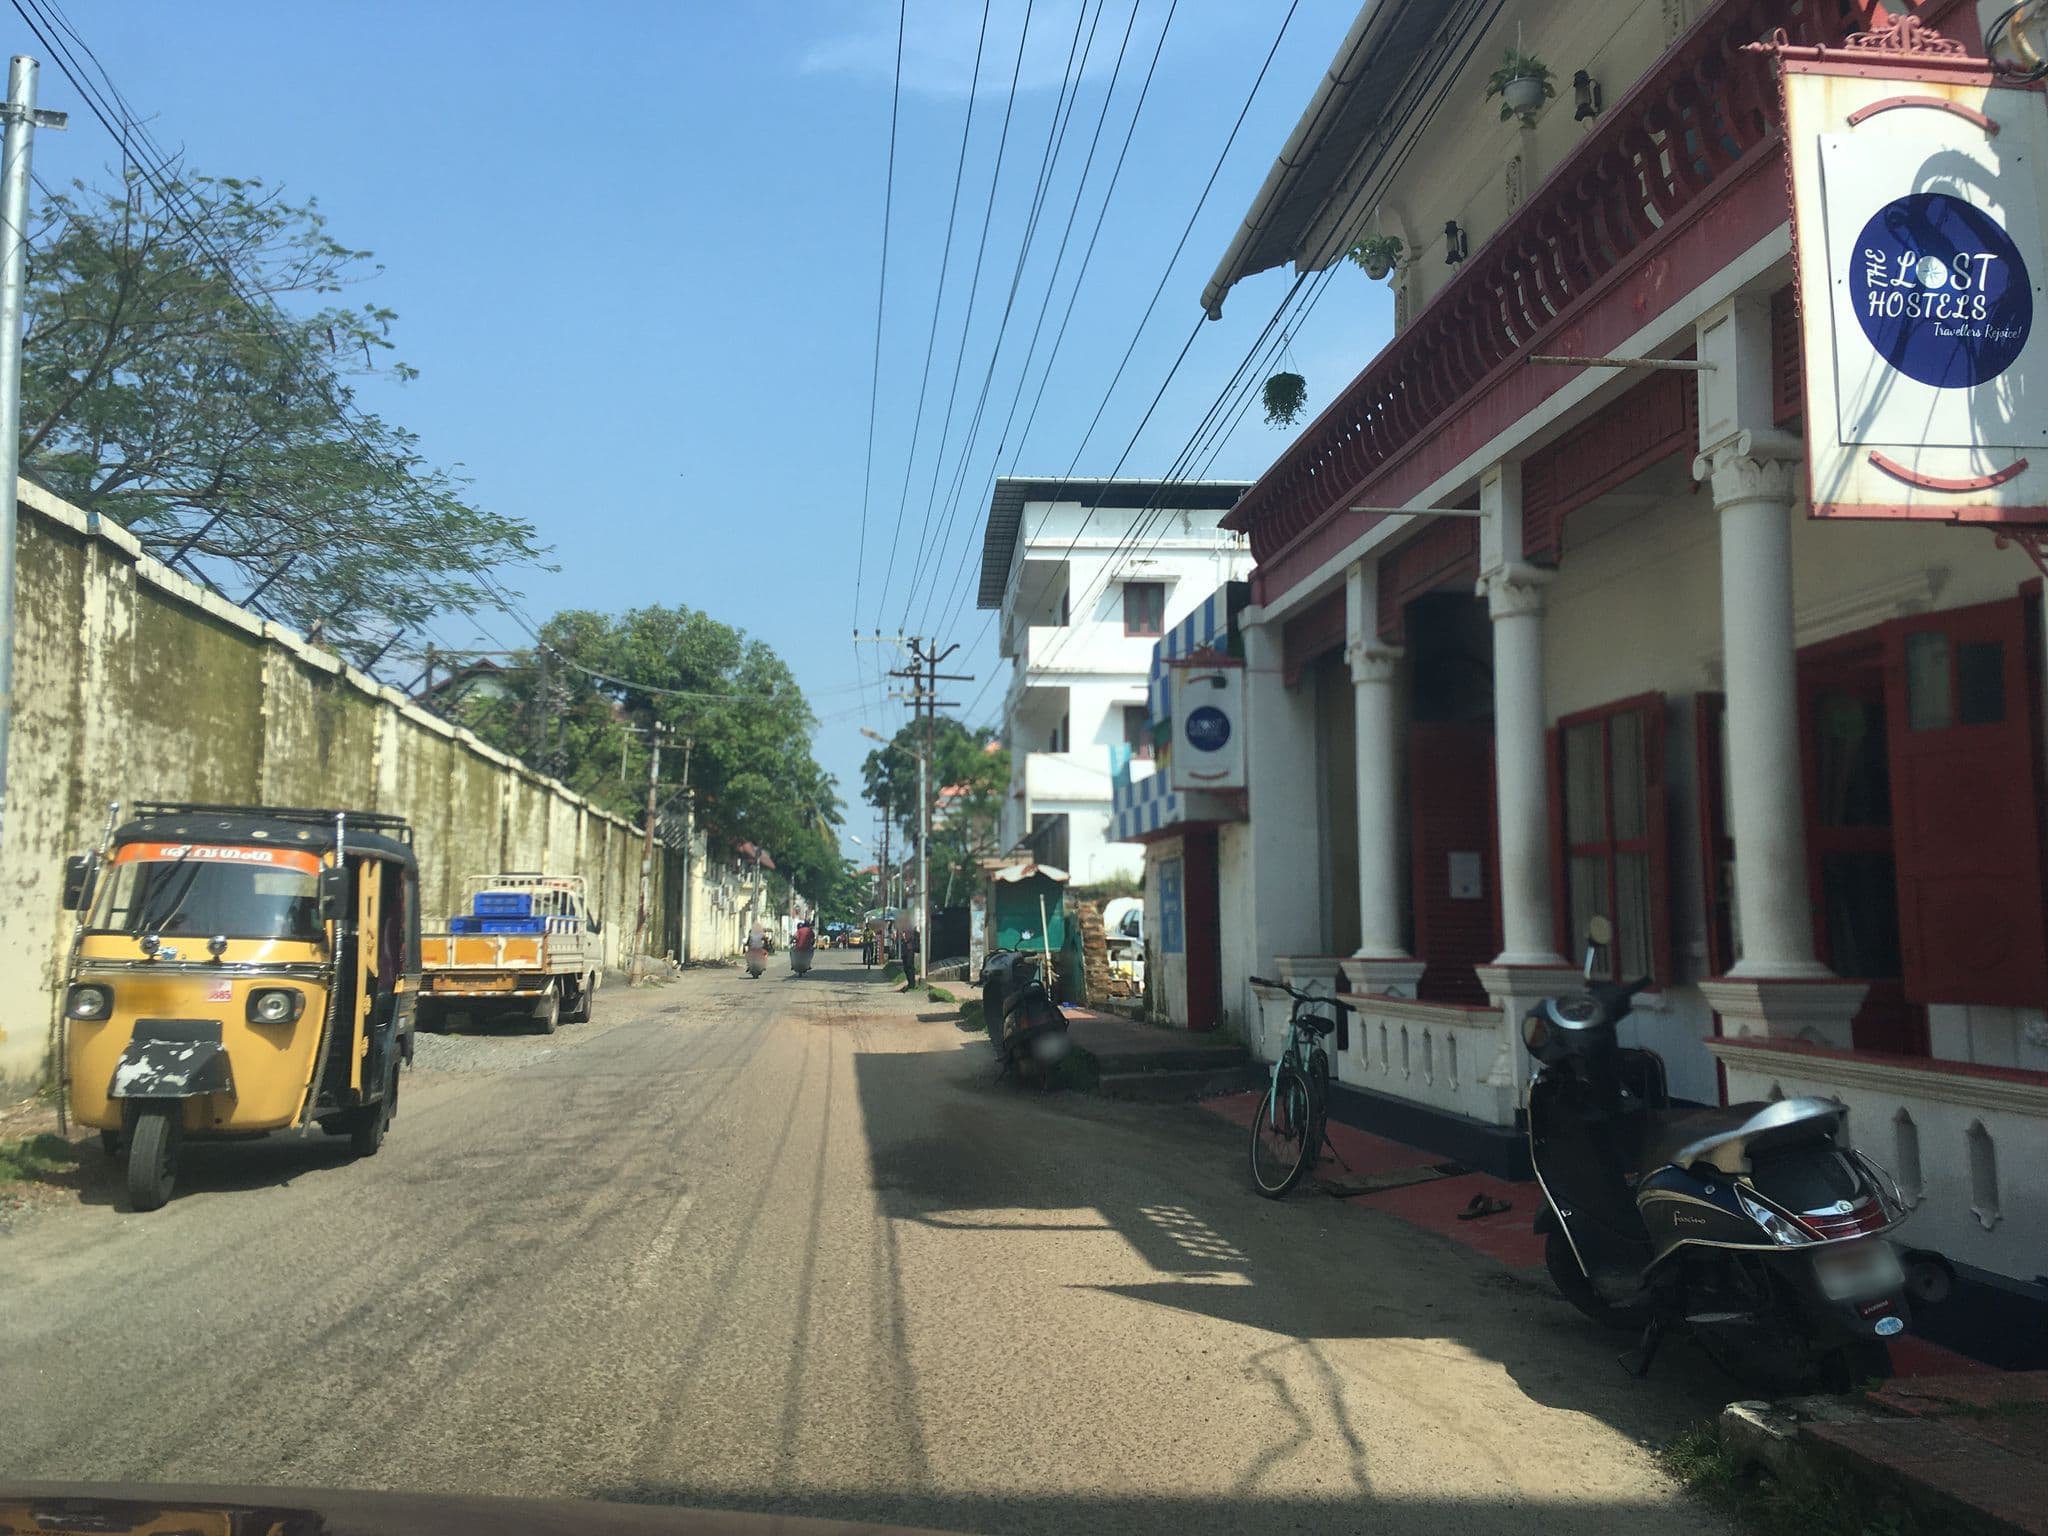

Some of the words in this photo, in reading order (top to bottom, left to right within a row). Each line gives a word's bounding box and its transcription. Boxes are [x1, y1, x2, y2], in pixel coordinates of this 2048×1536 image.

[1865, 249, 1888, 288] THE
[1890, 250, 1999, 291] LOST
[1868, 290, 1987, 320] HOSTELS
[1934, 322, 1981, 337] Travellers
[1984, 323, 2022, 341] Rejoice!
